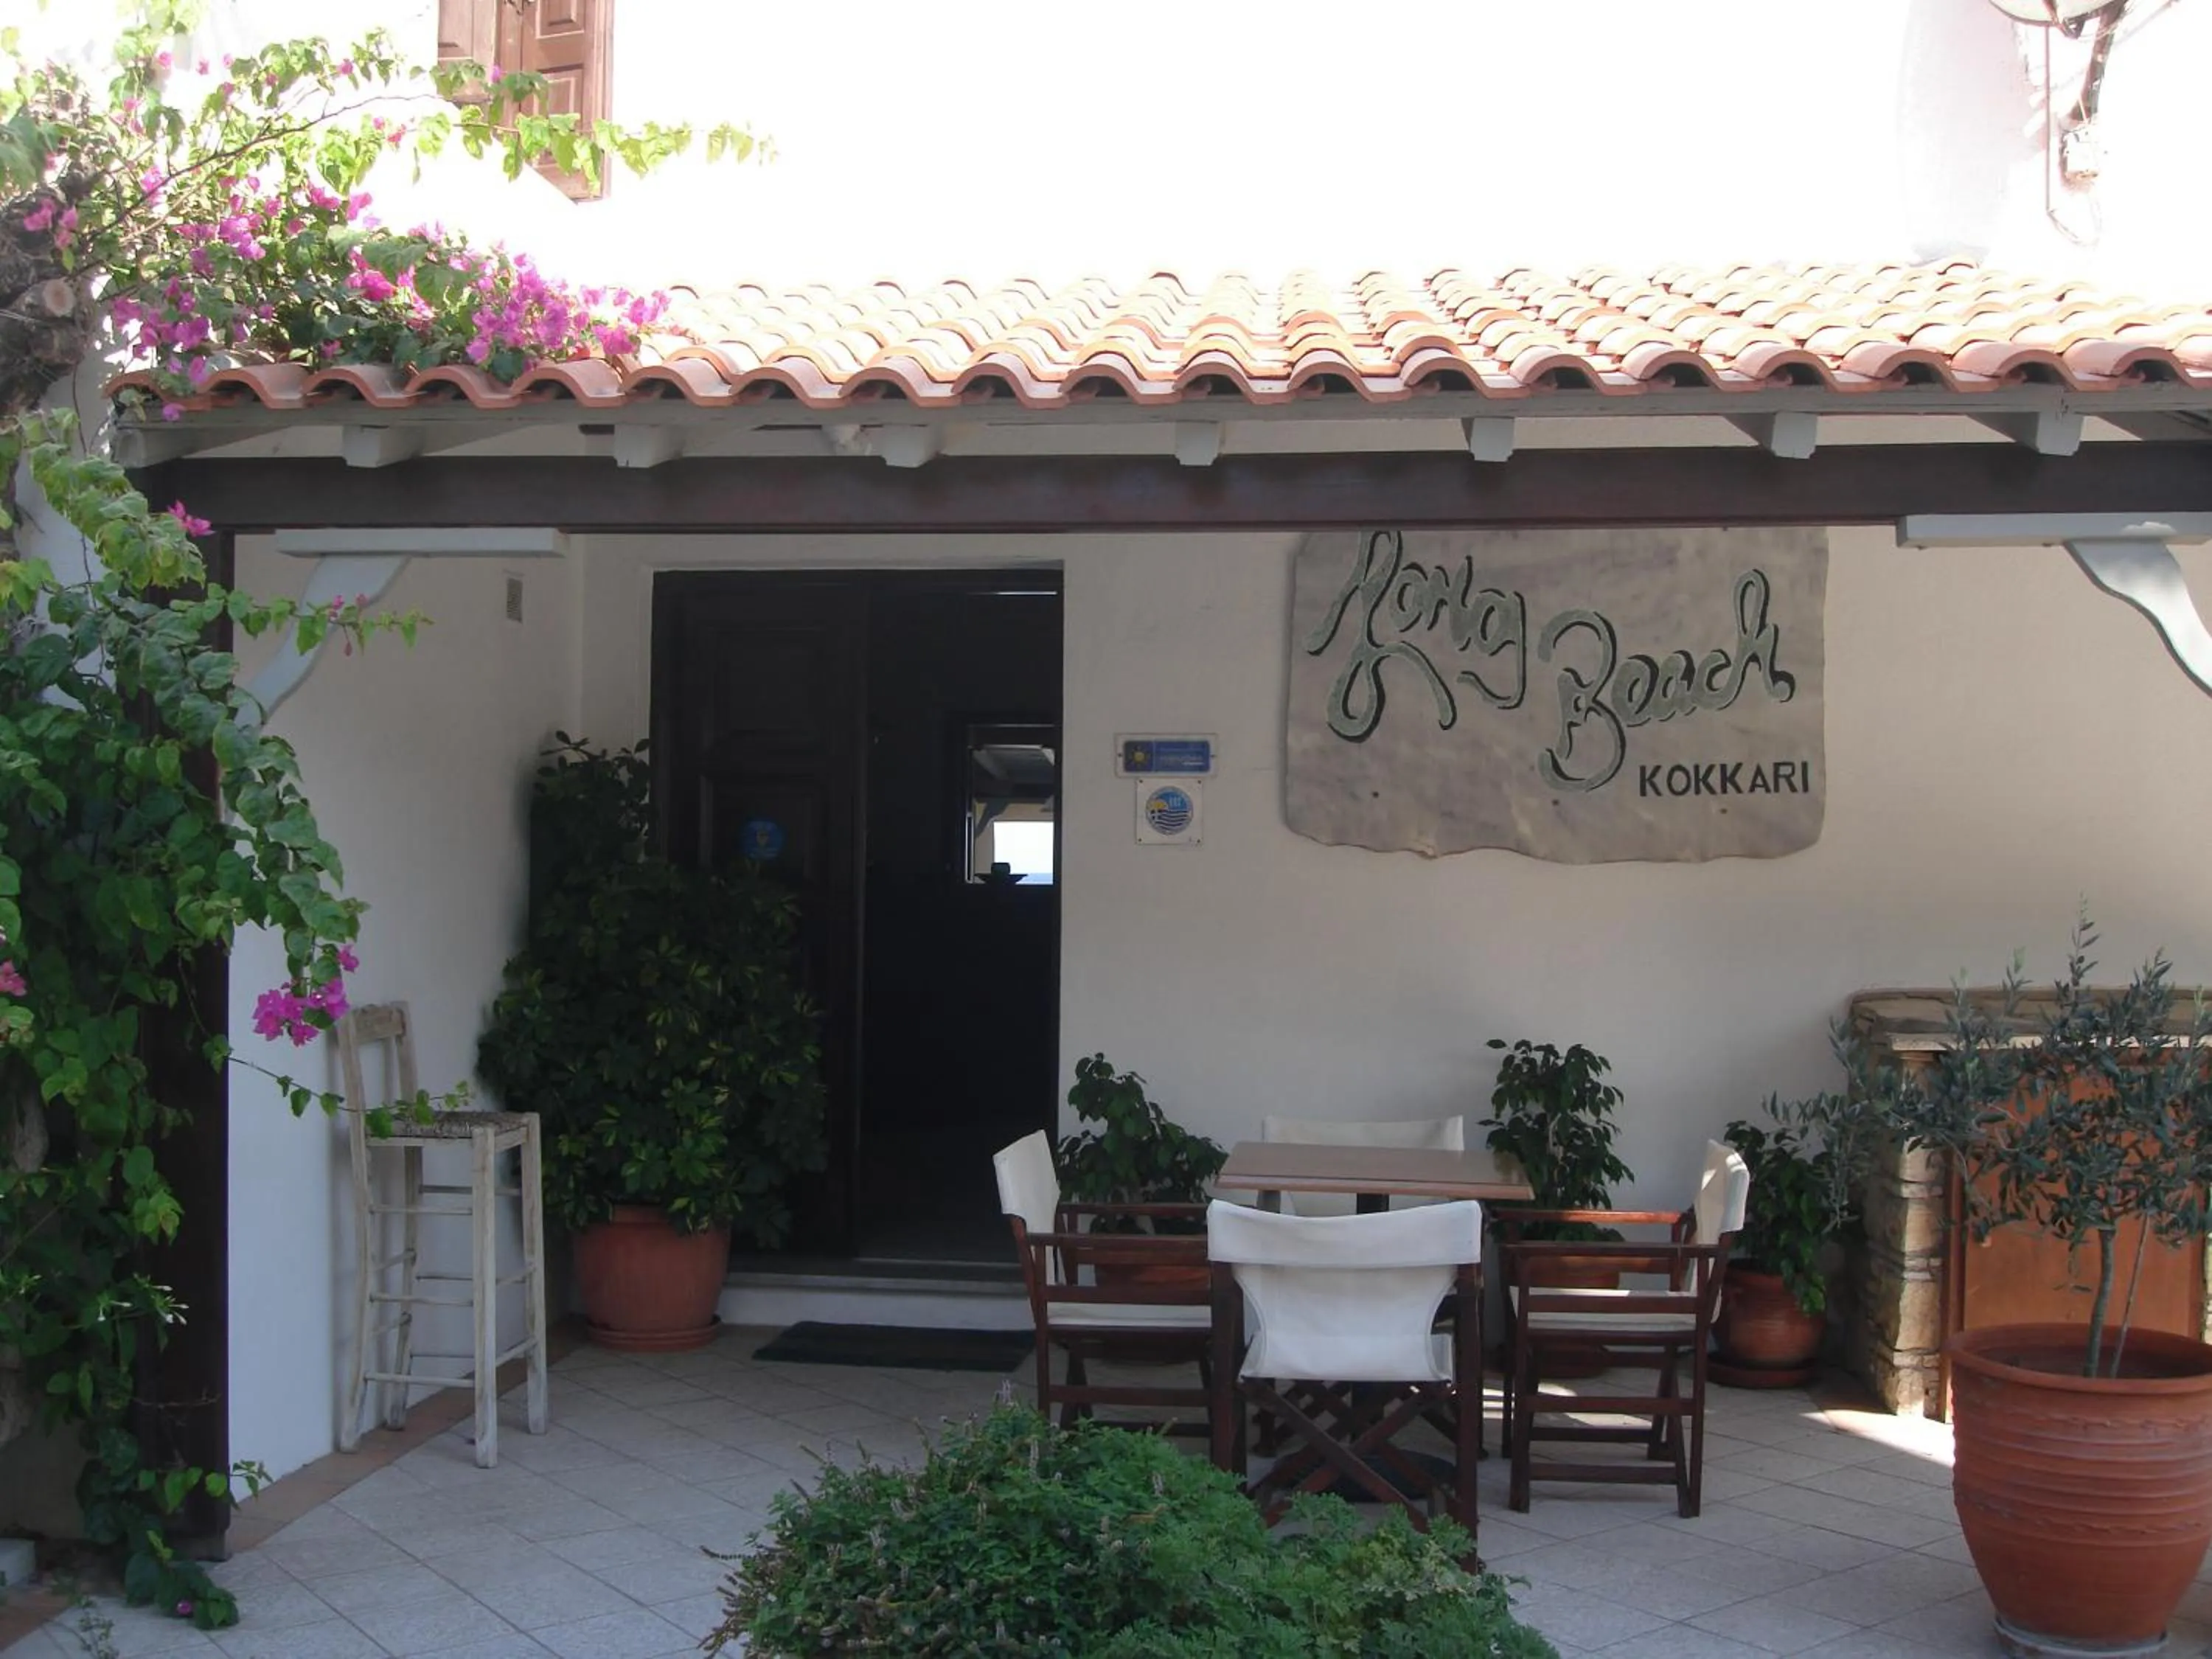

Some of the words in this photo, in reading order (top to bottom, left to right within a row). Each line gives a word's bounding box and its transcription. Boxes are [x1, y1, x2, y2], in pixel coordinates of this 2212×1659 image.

[1307, 530, 1526, 743] Long
[1537, 567, 1796, 793] Beach
[1639, 762, 1809, 797] KOKKARI
